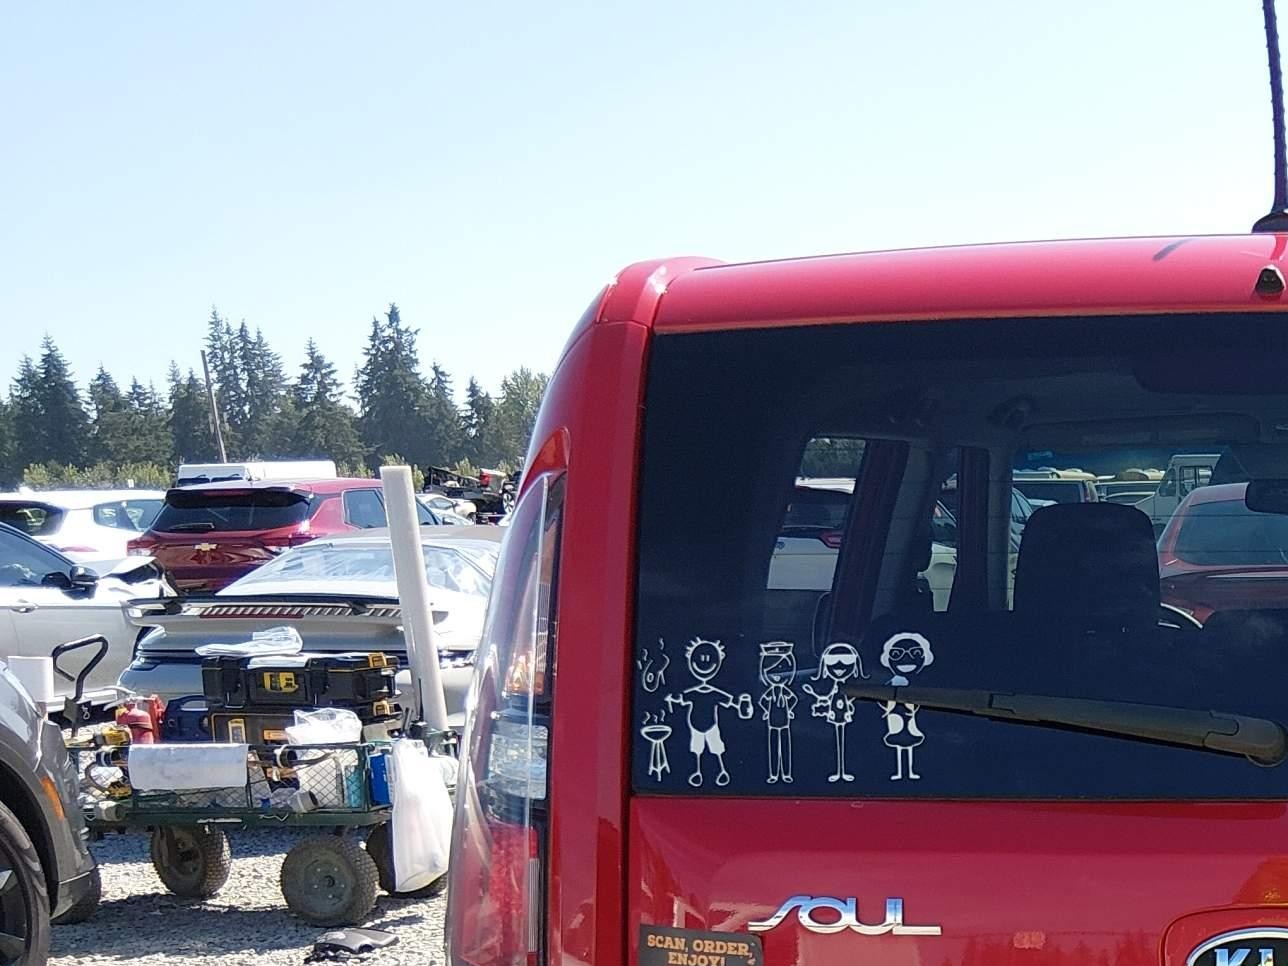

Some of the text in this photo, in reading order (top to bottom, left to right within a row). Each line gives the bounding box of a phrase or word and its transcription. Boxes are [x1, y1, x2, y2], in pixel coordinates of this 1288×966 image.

[748, 895, 942, 936] SOUL
[647, 934, 754, 958] SCAN, ORDER,
